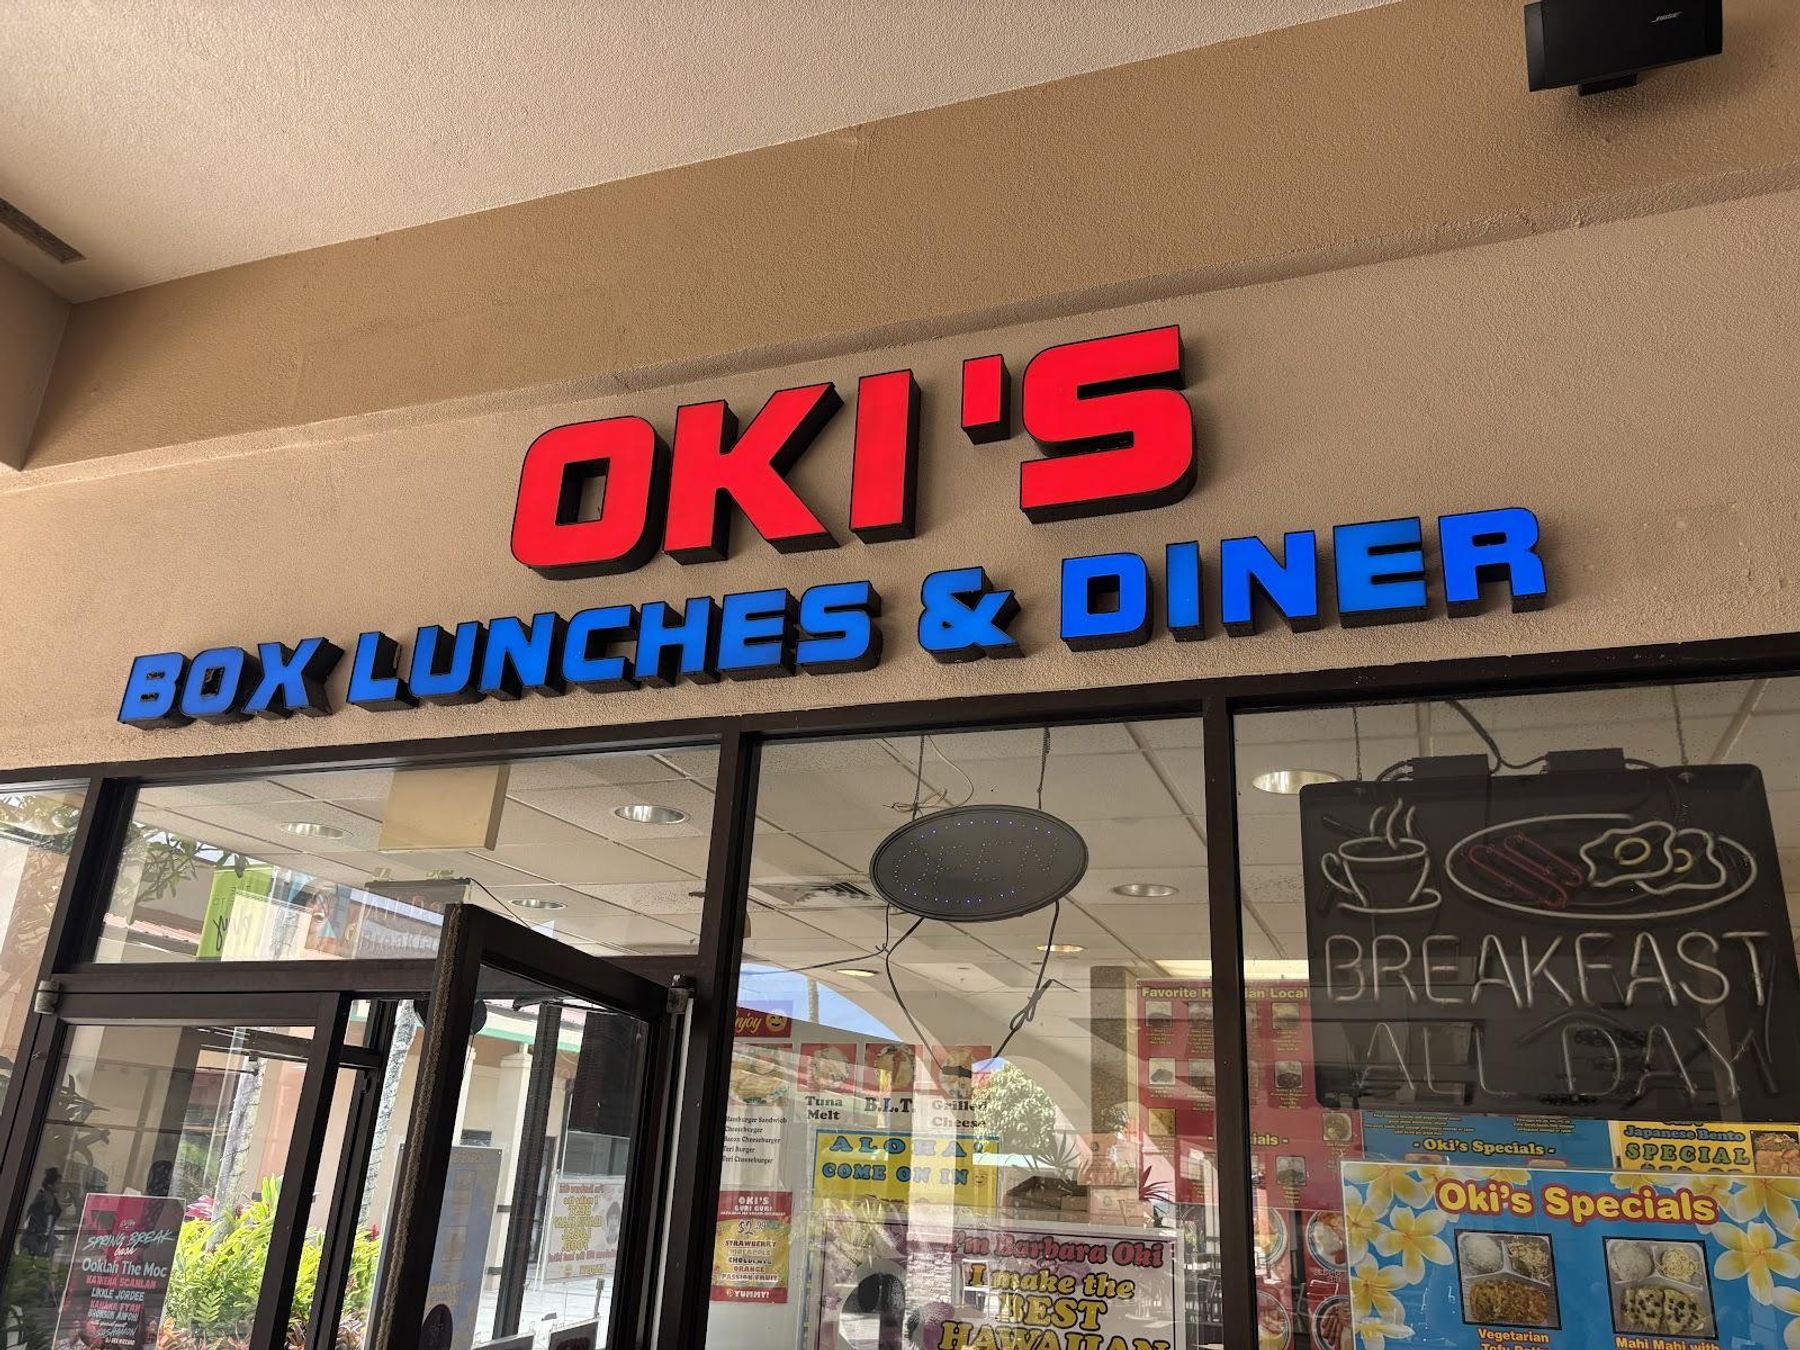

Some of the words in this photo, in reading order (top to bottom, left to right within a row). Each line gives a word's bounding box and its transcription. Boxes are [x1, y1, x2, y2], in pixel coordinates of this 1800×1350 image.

[511, 325, 1198, 570] OKI'S
[118, 637, 330, 725] BOX
[347, 580, 876, 704] LUNCHES
[918, 566, 1016, 653] &
[1061, 507, 1547, 639] DINER
[1325, 931, 1769, 1008] BREAKFAST
[1142, 986, 1197, 999] Favorite
[1270, 987, 1308, 999] Local
[735, 1010, 762, 1033] njoy
[1358, 1022, 1512, 1097] ALL
[1562, 1023, 1756, 1099] DAY
[805, 1095, 843, 1108] Tuna
[932, 1099, 988, 1112] Grilled
[807, 1109, 841, 1121] Melt
[932, 1116, 987, 1129] Cheese
[742, 1136, 781, 1144] Cheeseburger
[1624, 1125, 1697, 1140] Japanese
[1697, 1128, 1746, 1142] Bento
[1423, 1138, 1468, 1153] Oki's
[1471, 1140, 1546, 1157] Specials
[1625, 1143, 1751, 1166] SPECIAL
[822, 1162, 887, 1181] COME
[896, 1165, 930, 1185] ON
[940, 1167, 969, 1185] IN
[738, 1196, 770, 1205] OKI'S
[1436, 1179, 1535, 1215] Oki's
[1541, 1184, 1719, 1226] Specials
[82, 1233, 126, 1251] SPRING
[127, 1228, 176, 1247] BREAK
[725, 1240, 776, 1248] STRAWBERRY
[950, 1231, 990, 1255] I'm
[994, 1234, 1107, 1264] Barbara
[1112, 1241, 1164, 1268] Oki
[82, 1257, 119, 1275] Ooklah
[121, 1260, 142, 1277] The
[143, 1262, 168, 1279] Moc
[721, 1273, 754, 1281] PASSION
[733, 1265, 765, 1273] ORANGE
[969, 1263, 987, 1287] I
[991, 1268, 1076, 1295] make
[1084, 1272, 1136, 1299] the
[735, 1290, 770, 1299] YUMMY!
[997, 1291, 1108, 1331] BEST
[1478, 1328, 1549, 1343] Vegetarian
[1615, 1336, 1649, 1350] Mahi
[1652, 1339, 1686, 1350] Mahi
